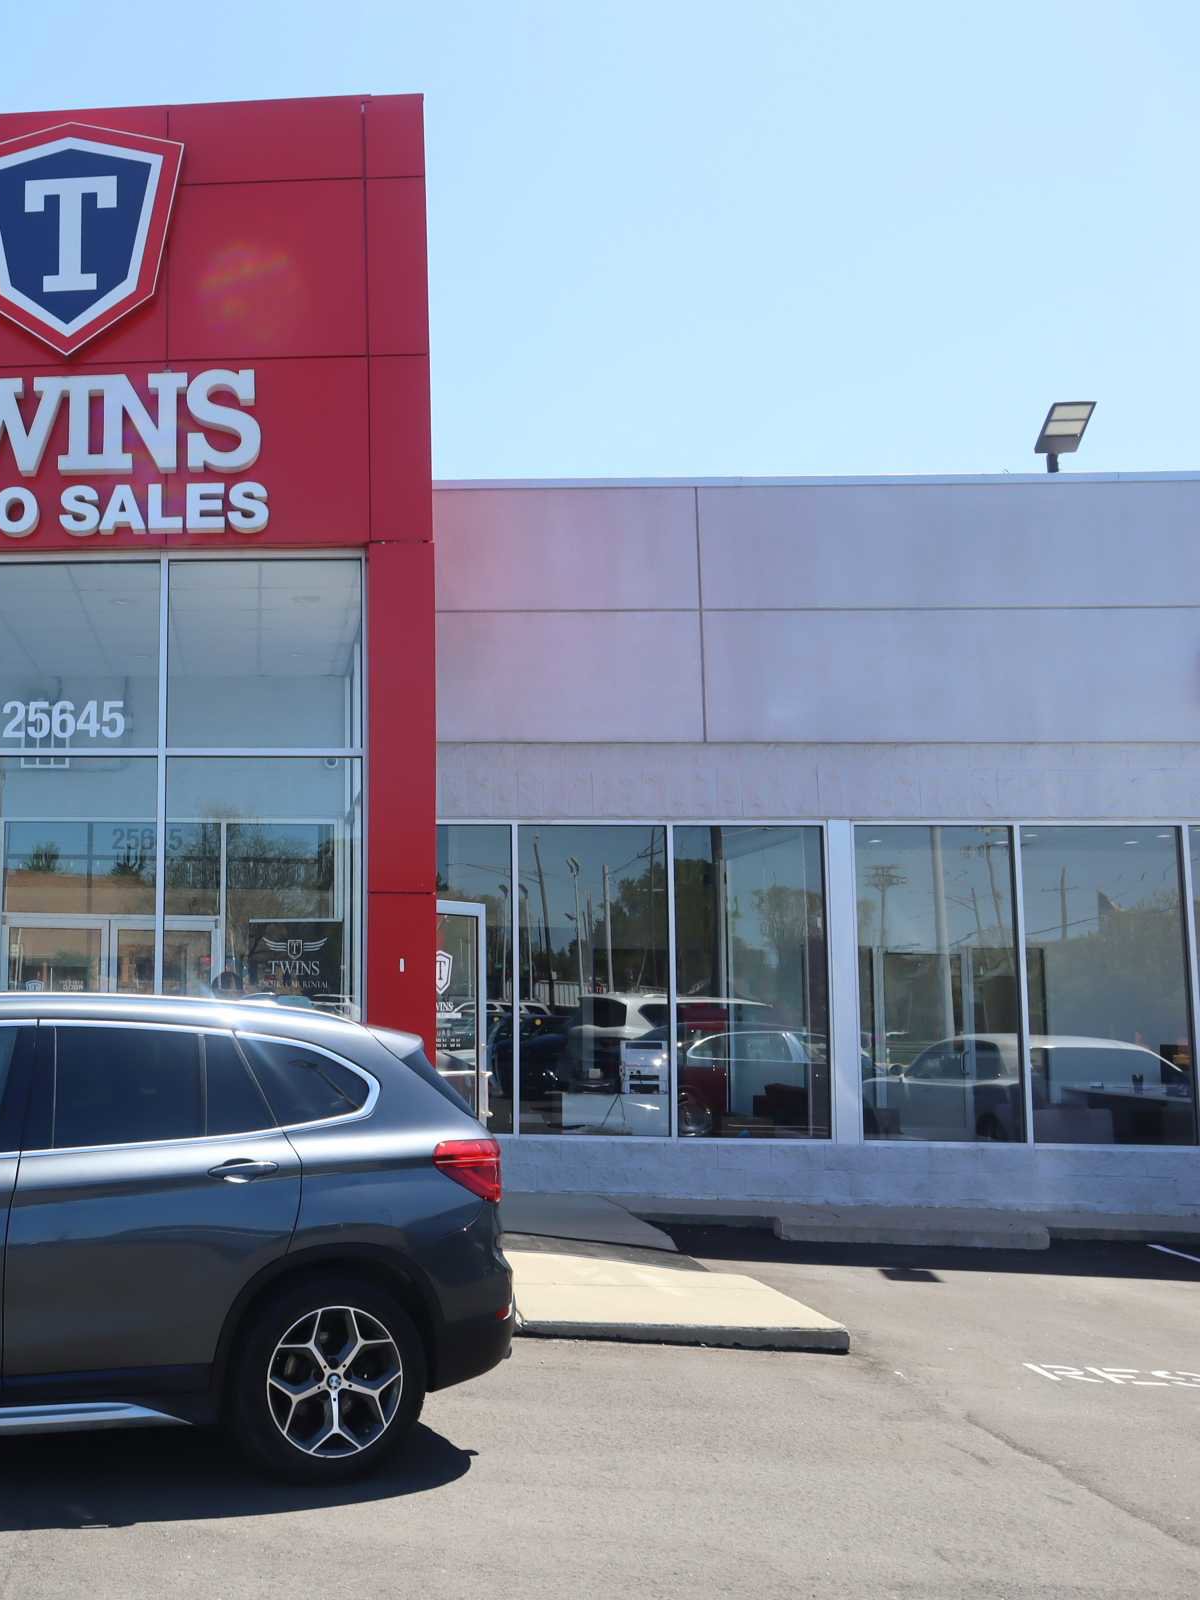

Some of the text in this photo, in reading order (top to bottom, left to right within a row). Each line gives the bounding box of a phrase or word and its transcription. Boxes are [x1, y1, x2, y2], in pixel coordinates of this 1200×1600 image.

[24, 175, 118, 293] T
[59, 481, 270, 537] SALES
[2, 700, 126, 738] 25645
[270, 960, 320, 976] TWINS
